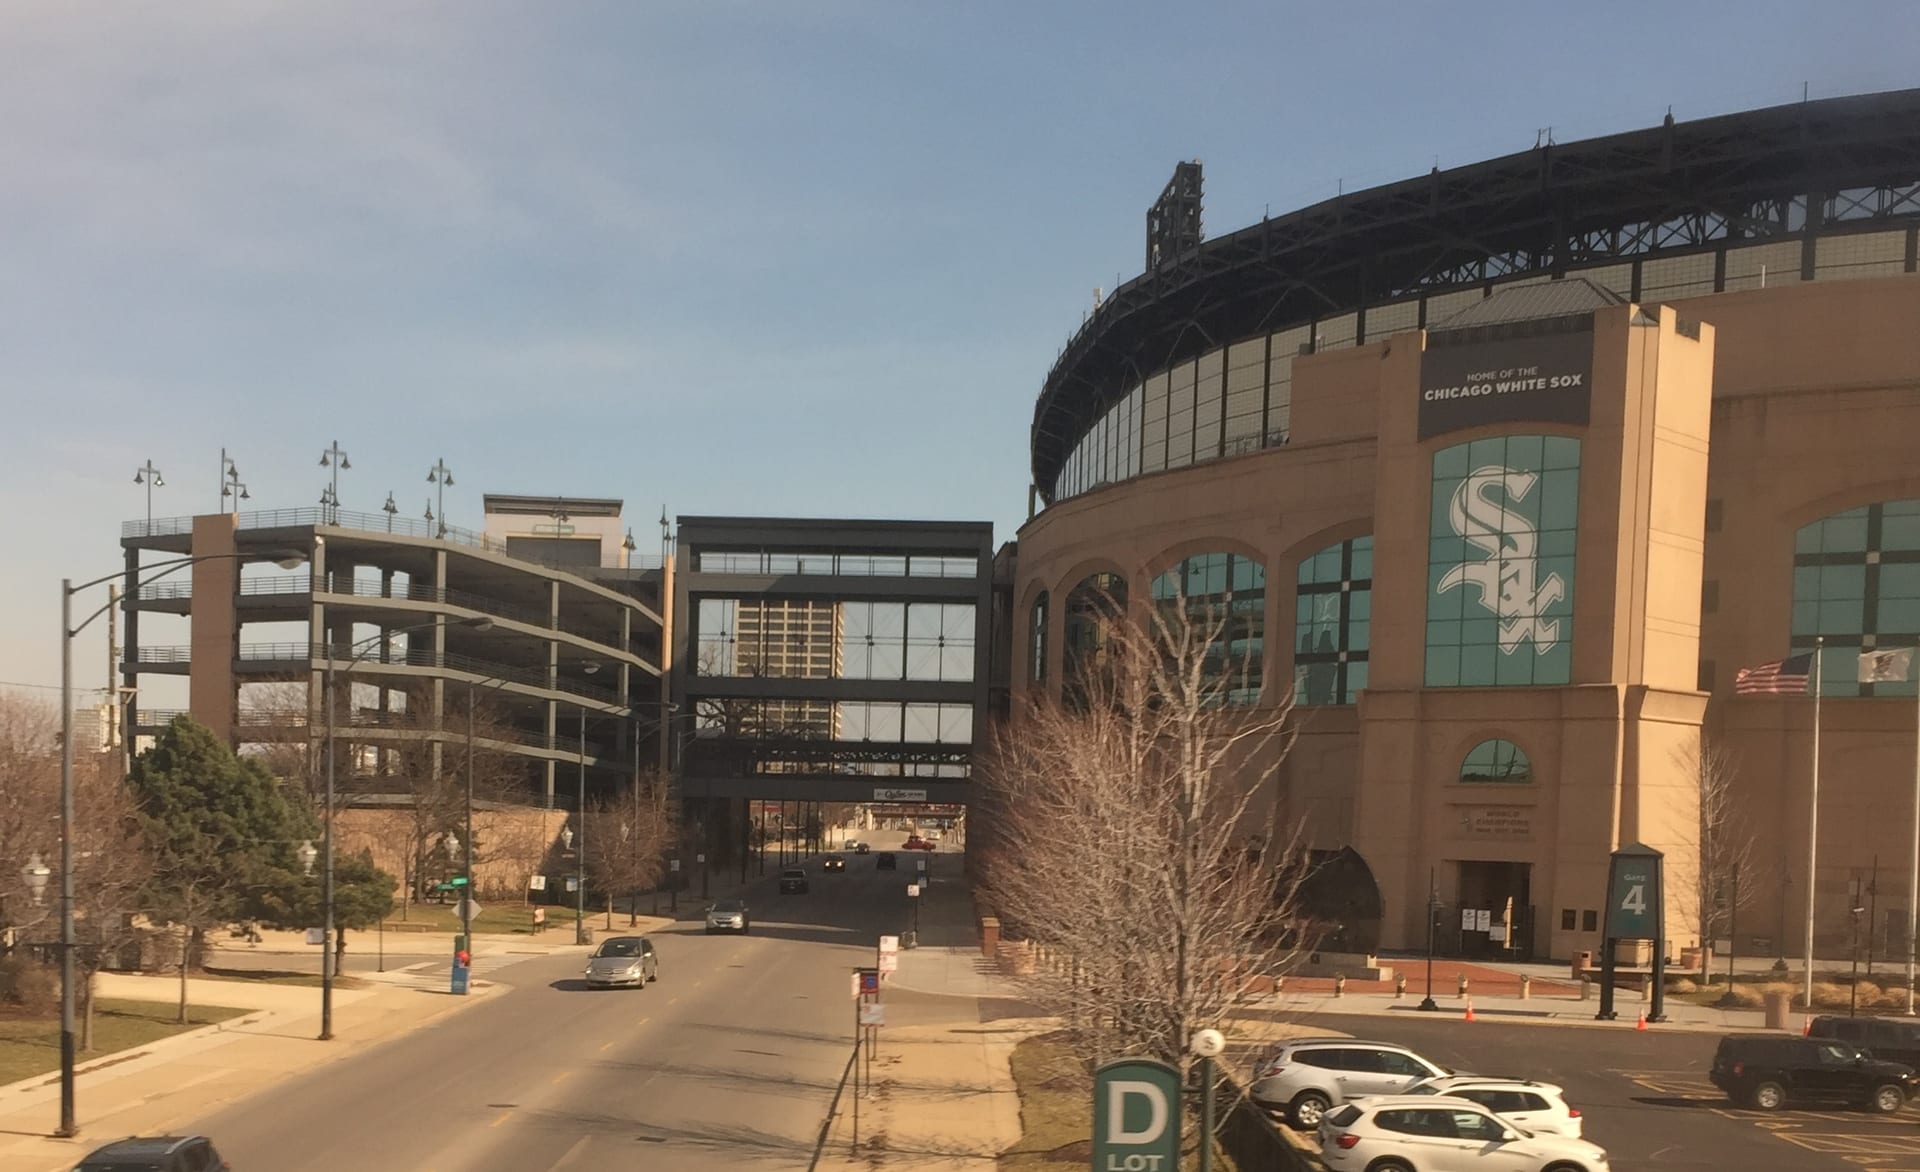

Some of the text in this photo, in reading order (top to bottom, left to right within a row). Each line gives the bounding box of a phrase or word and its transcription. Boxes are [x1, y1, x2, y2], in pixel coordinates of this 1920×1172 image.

[1424, 373, 1582, 401] CHICAGO WHITE SOX
[1467, 366, 1539, 382] HOME OF THE
[1621, 884, 1647, 915] 4
[1106, 1081, 1168, 1145] D
[1107, 1153, 1165, 1172] LOT
